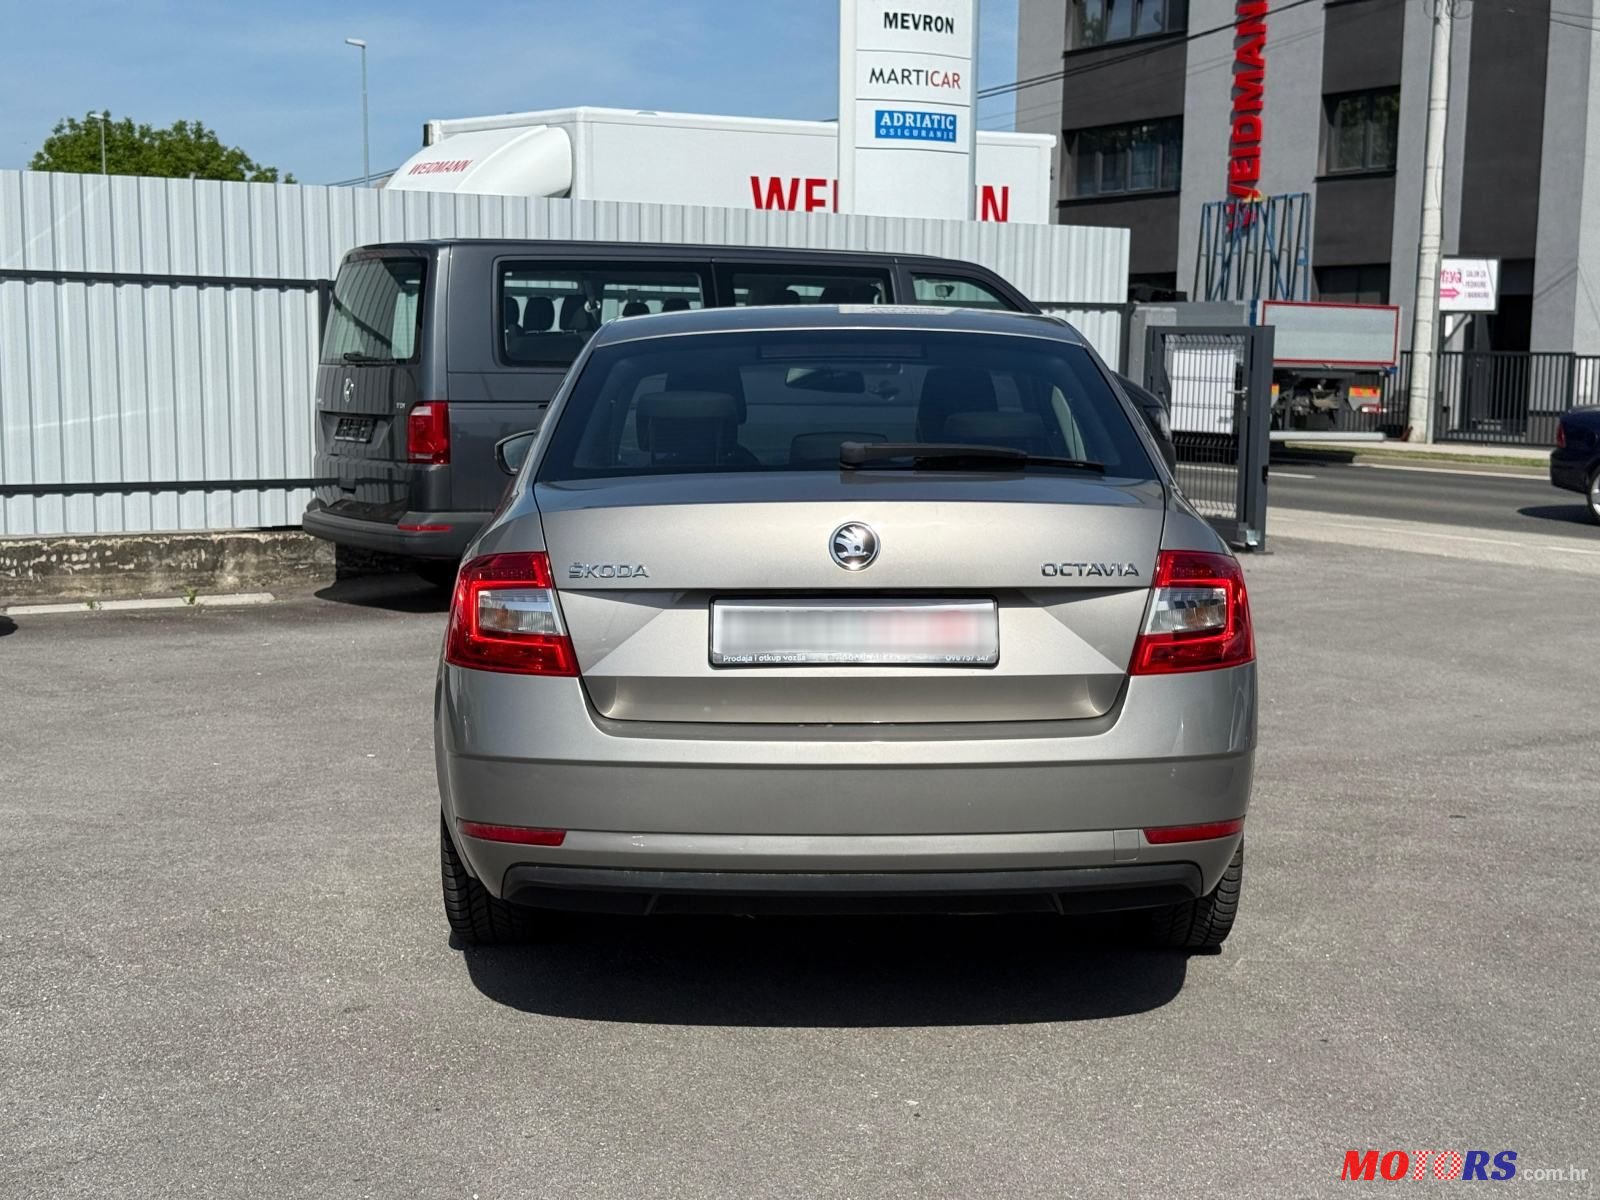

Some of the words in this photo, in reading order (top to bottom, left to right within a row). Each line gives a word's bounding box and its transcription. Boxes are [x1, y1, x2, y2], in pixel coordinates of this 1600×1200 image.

[884, 12, 954, 34] MEVRON
[869, 68, 961, 89] MARTICAR
[880, 112, 954, 130] ADRIATIC
[1041, 563, 1140, 577] OCTAVIA
